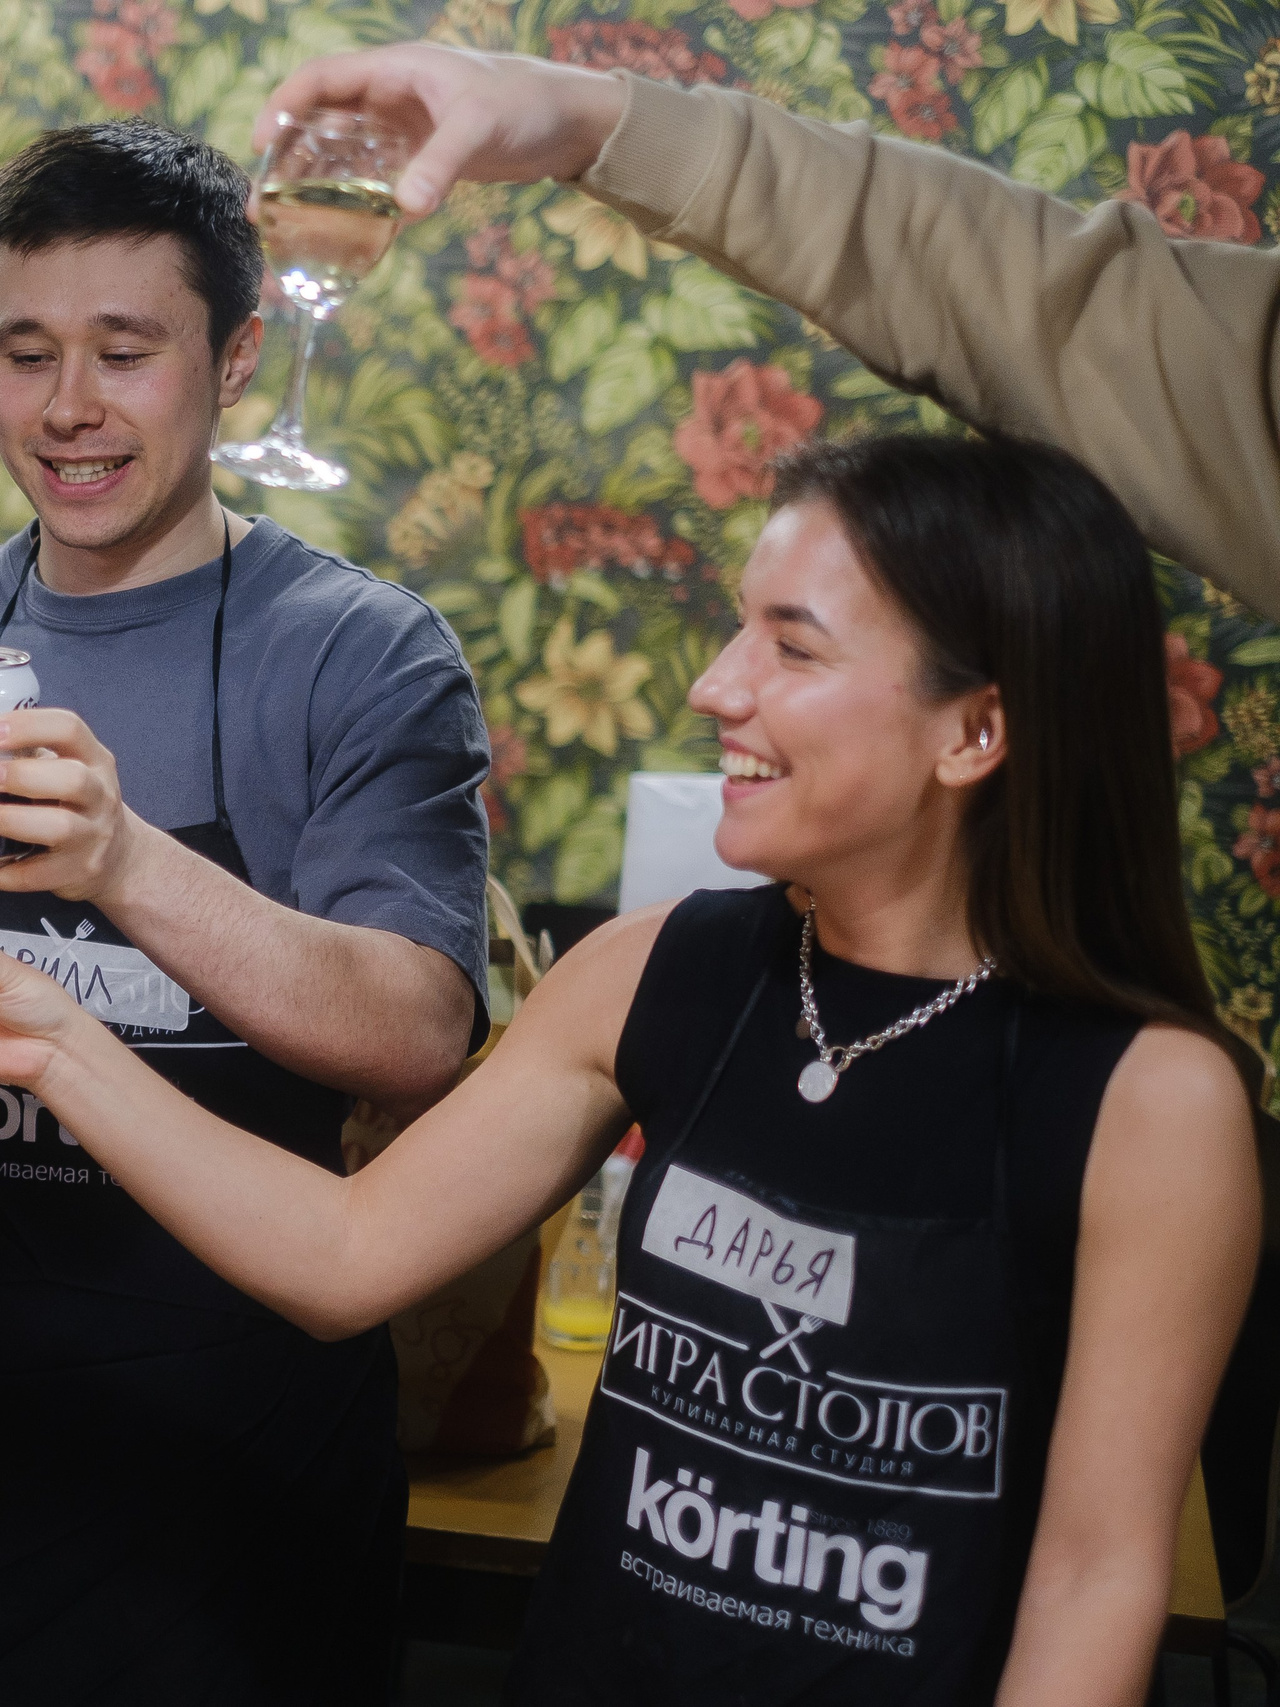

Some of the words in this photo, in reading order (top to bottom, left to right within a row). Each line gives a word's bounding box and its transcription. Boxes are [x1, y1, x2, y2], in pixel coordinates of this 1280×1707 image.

[674, 1204, 836, 1298] ДАРЬЯ
[612, 1308, 728, 1407] ИГРА
[742, 1366, 994, 1458] СТОЛОВ
[651, 1384, 798, 1452] КУЛИНАРНАЯ
[810, 1443, 916, 1477] СТУДИЯ
[626, 1446, 929, 1632] körting
[867, 1518, 913, 1542] 1889
[620, 1549, 793, 1632] встраиваемая
[800, 1613, 916, 1658] техника
